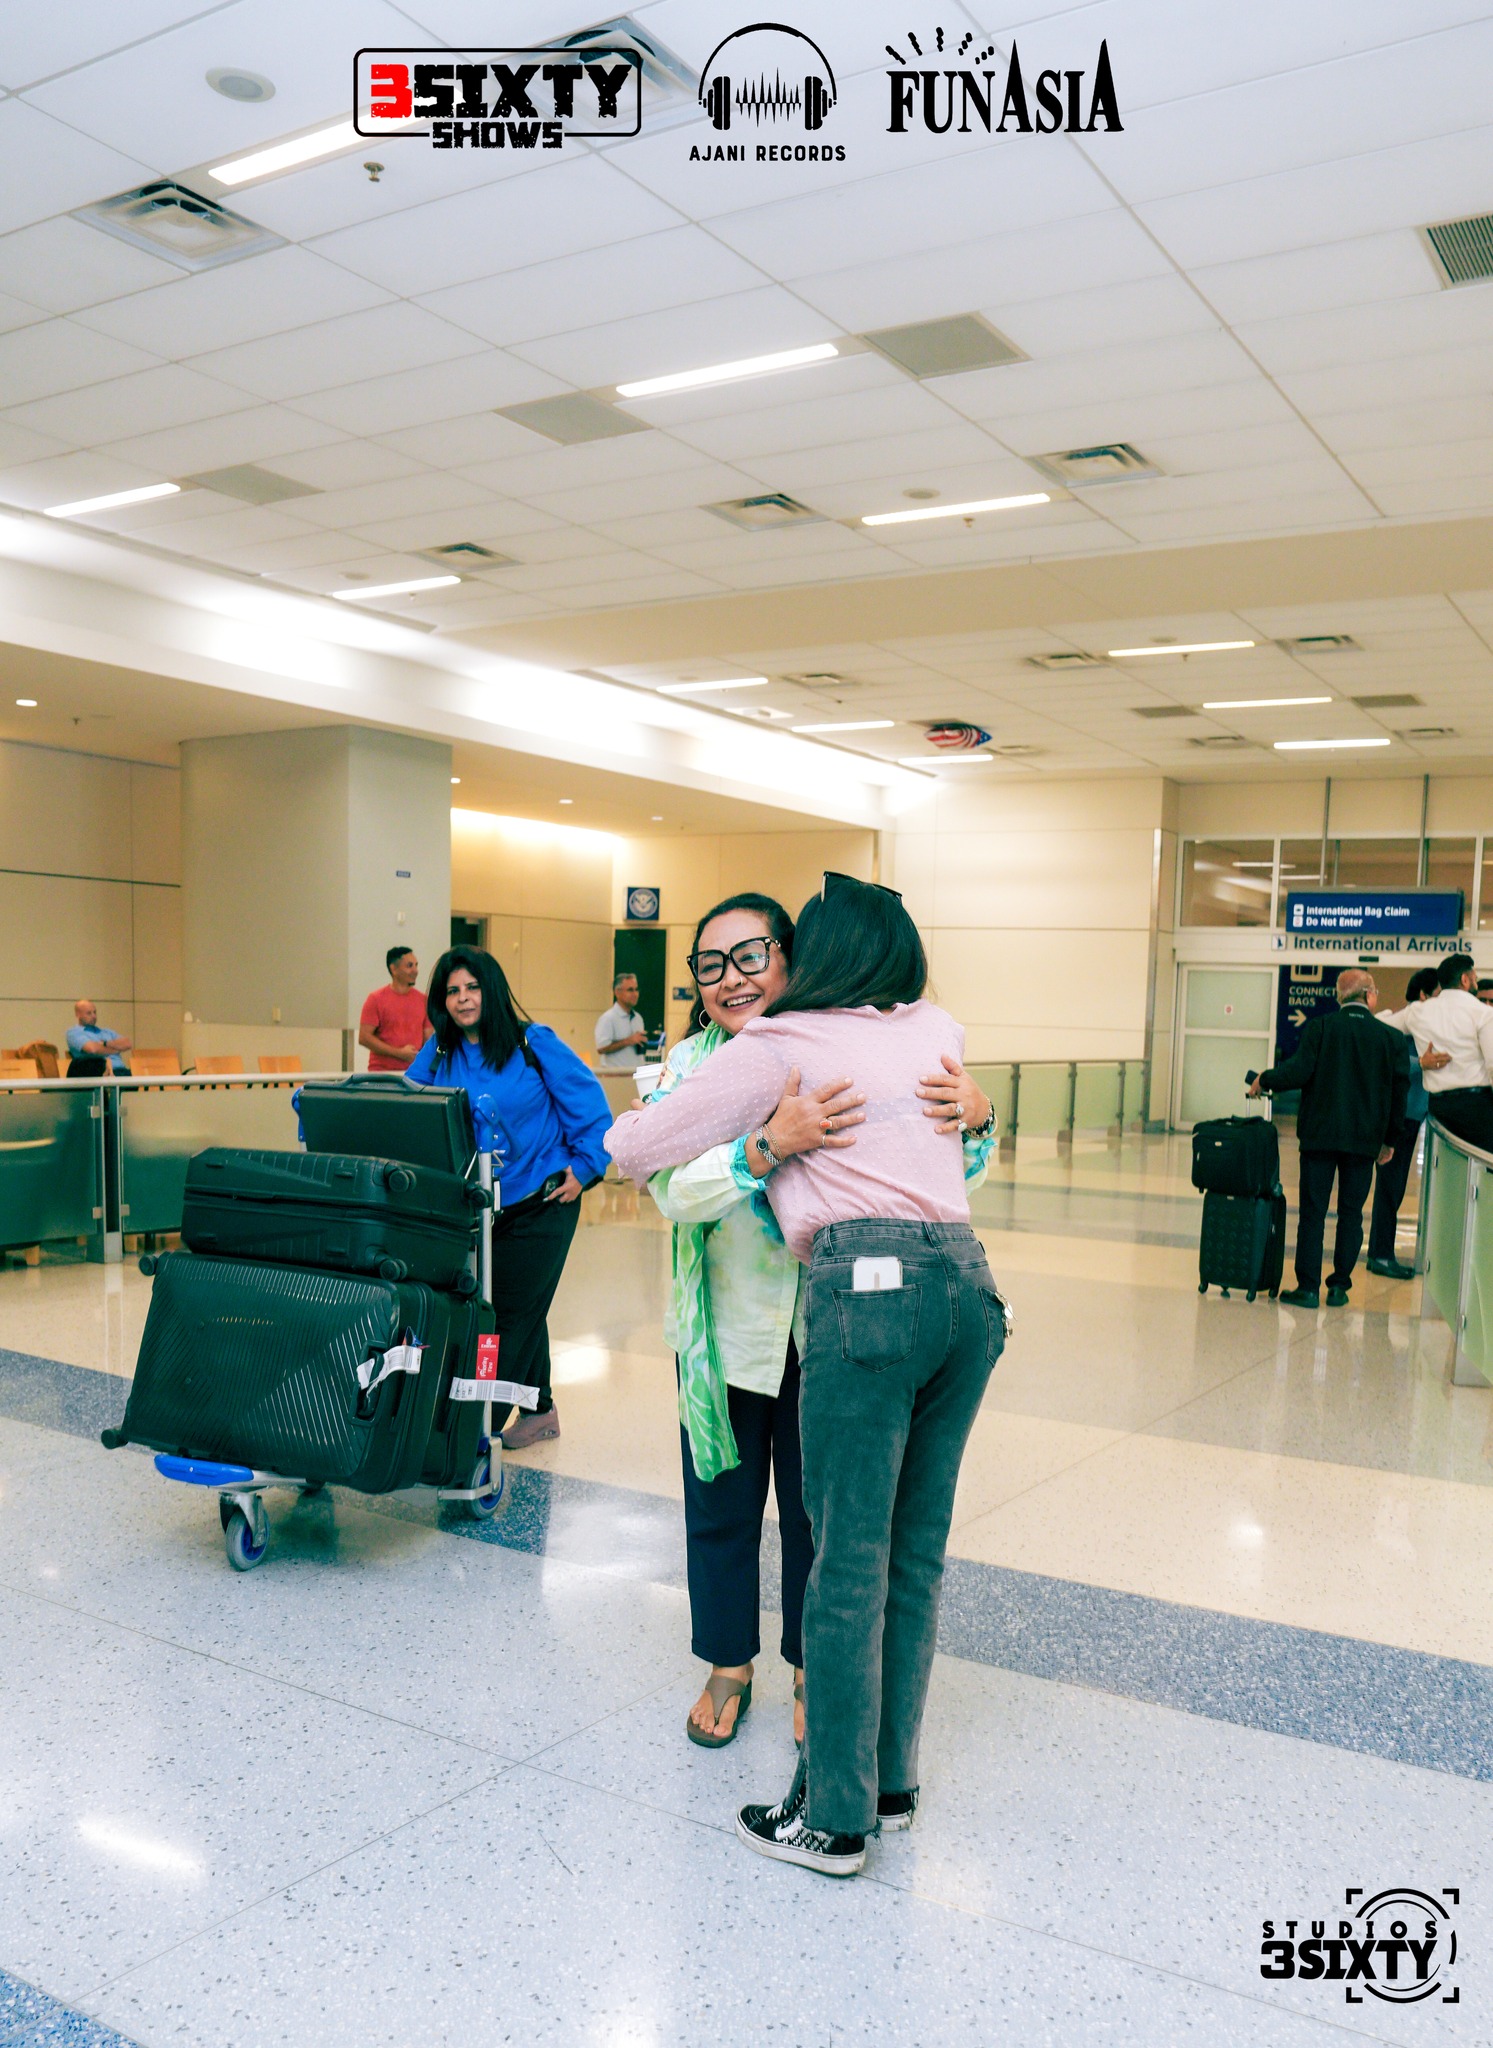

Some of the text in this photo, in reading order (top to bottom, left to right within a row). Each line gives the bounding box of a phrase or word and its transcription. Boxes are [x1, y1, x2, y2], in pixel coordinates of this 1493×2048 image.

[1306, 906, 1411, 919] International Bag Claim
[1306, 917, 1364, 927] Do Not Enter
[1294, 936, 1473, 953] International Arrivals
[1288, 997, 1316, 1007] BAGS
